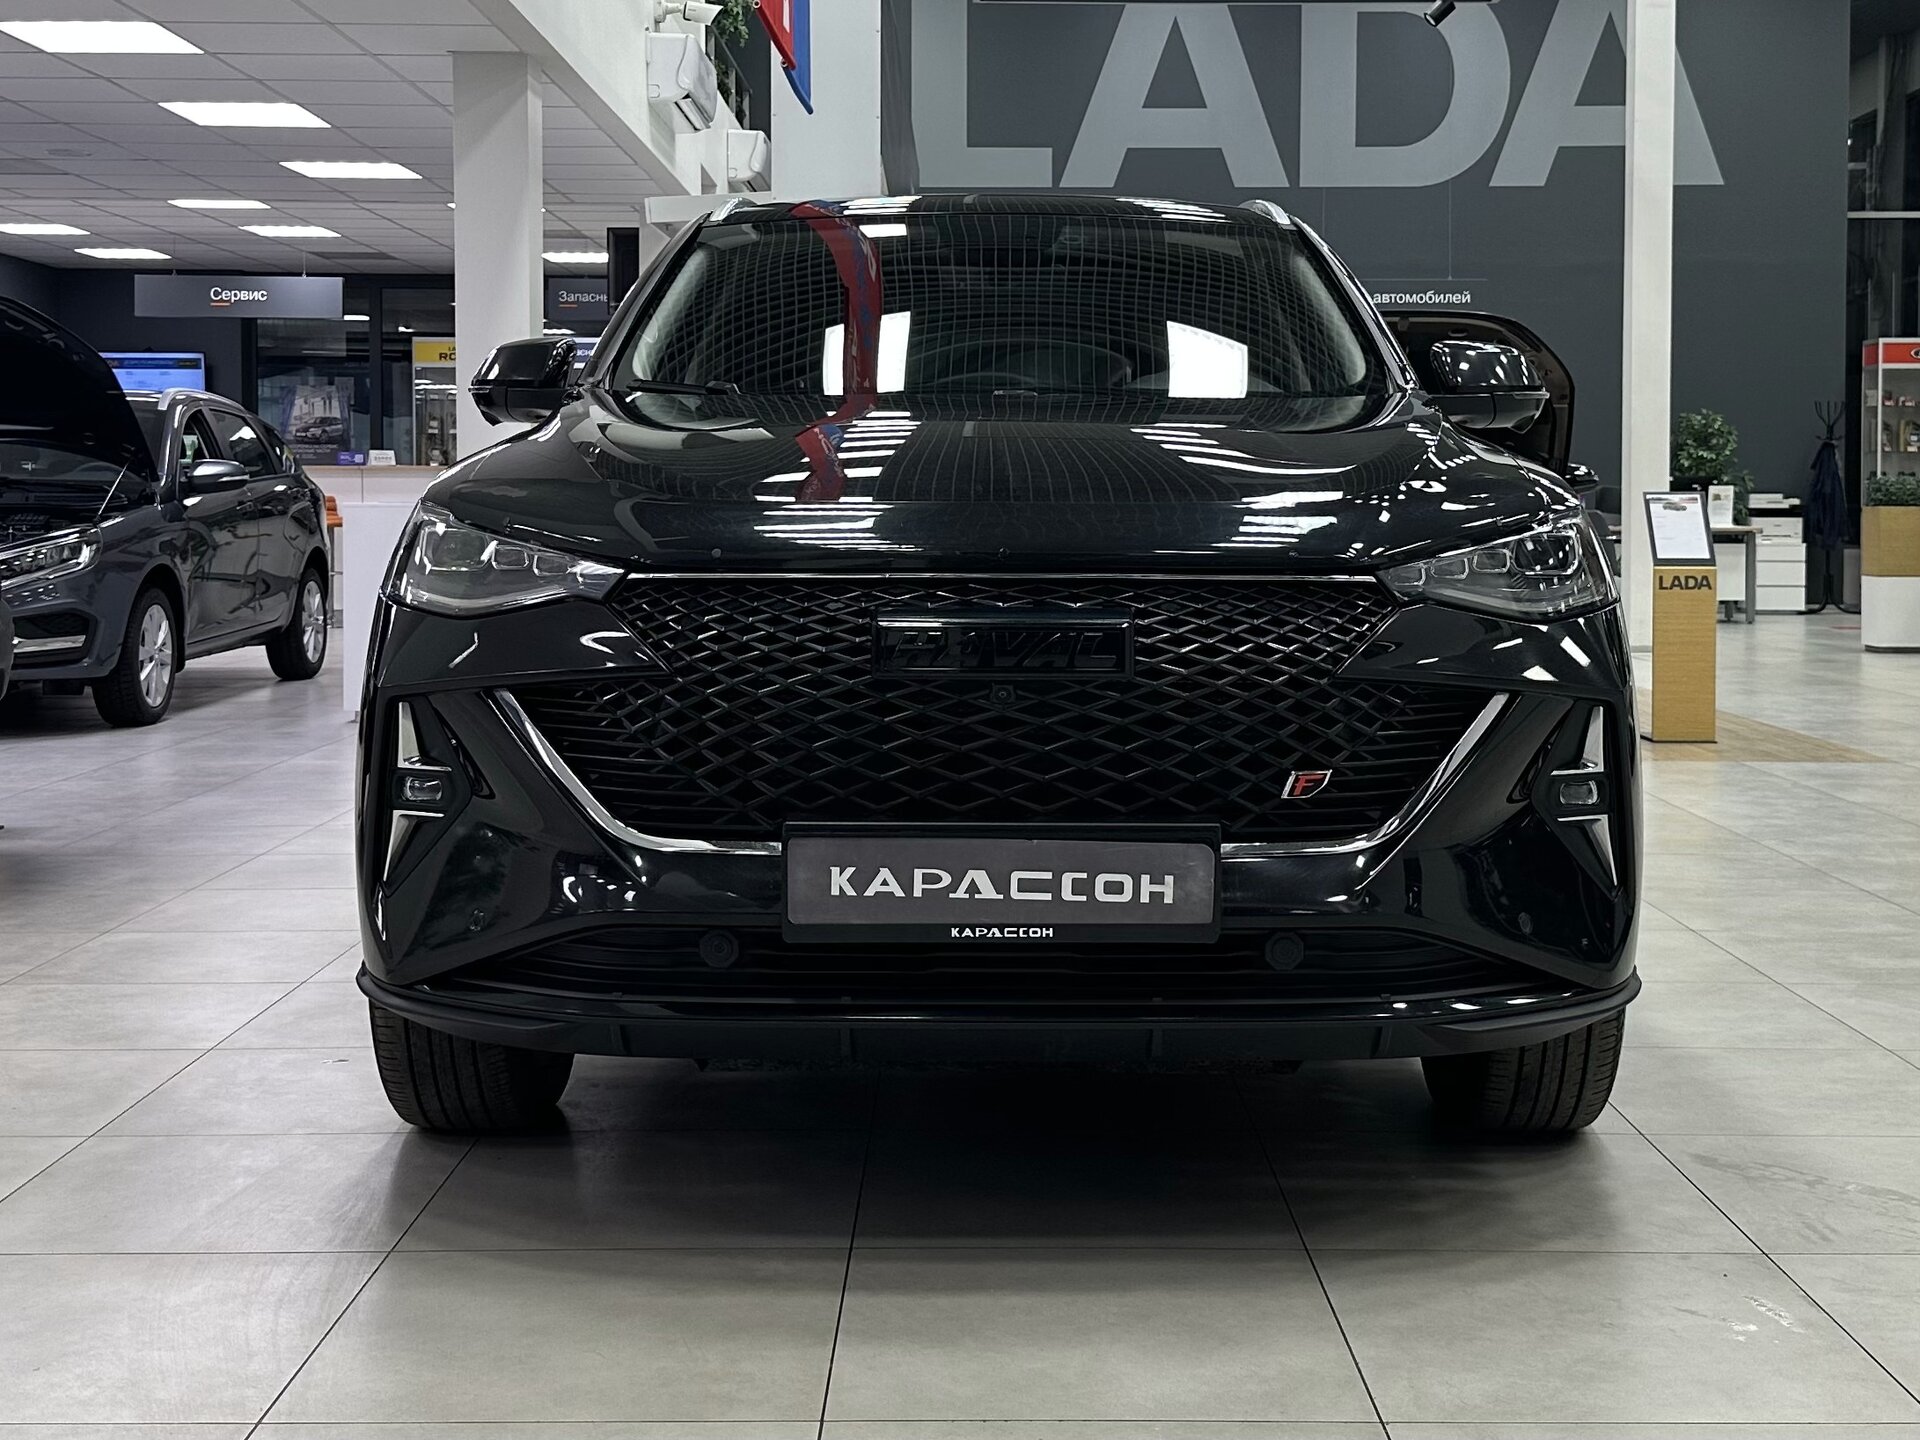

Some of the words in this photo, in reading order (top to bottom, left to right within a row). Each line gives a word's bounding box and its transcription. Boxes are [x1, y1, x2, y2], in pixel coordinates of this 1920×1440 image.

[911, 1, 1725, 188] LADA
[209, 286, 268, 304] Сервис
[1373, 290, 1472, 304] автомобилей
[1658, 575, 1712, 590] LADA
